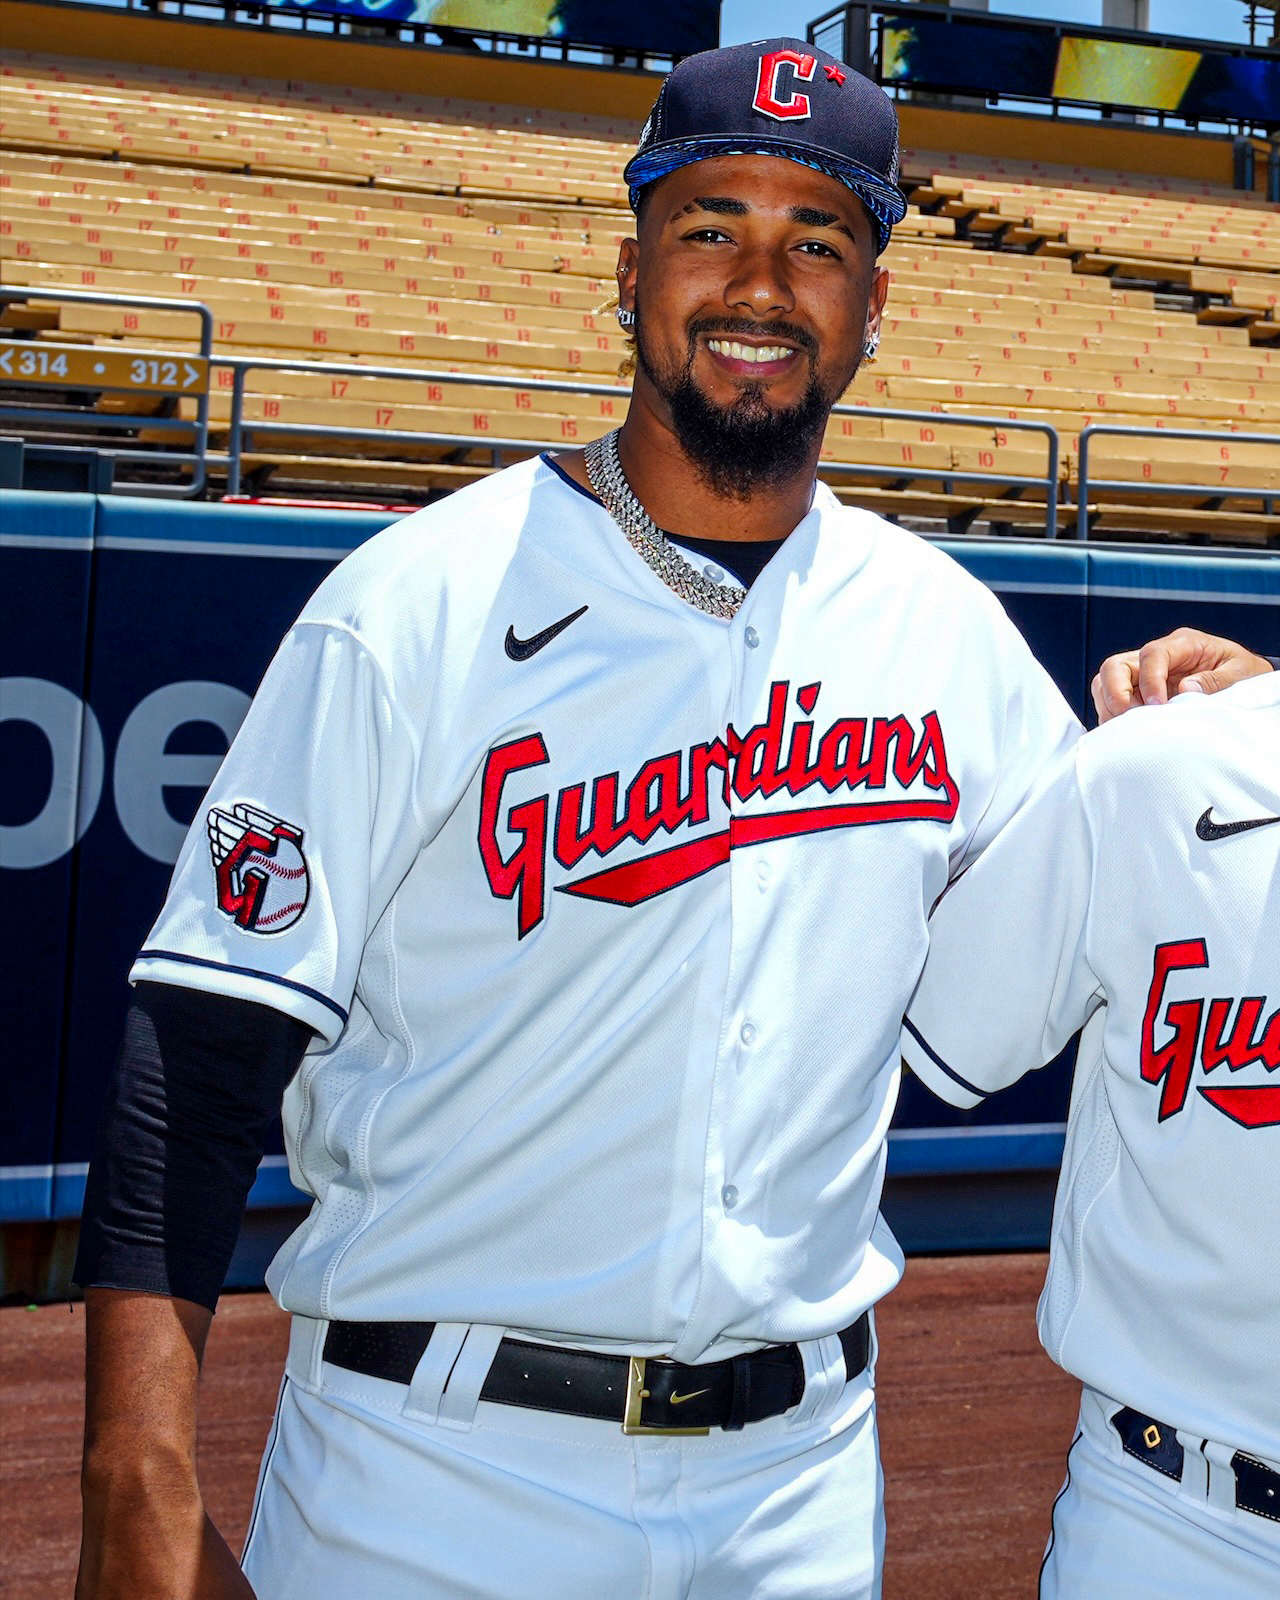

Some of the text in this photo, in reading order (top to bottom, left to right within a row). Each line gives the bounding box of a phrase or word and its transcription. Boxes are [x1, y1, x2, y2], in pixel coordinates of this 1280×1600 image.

[752, 49, 818, 122] C
[479, 284, 491, 300] 13
[355, 314, 372, 330] 15
[583, 314, 596, 330] 12
[219, 322, 237, 340] 17
[19, 350, 179, 388] 314 312
[217, 370, 234, 388] 18
[331, 380, 350, 398] 17
[427, 384, 443, 402] 16
[515, 392, 532, 408] 15
[600, 400, 614, 416] 14
[1168, 400, 1178, 416] 5
[264, 400, 281, 418] 18
[376, 408, 394, 426] 17
[473, 414, 489, 430] 16
[561, 420, 577, 436] 15
[842, 420, 854, 436] 11
[902, 446, 913, 462] 11
[978, 452, 994, 468] 10
[478, 681, 959, 941] Guardians
